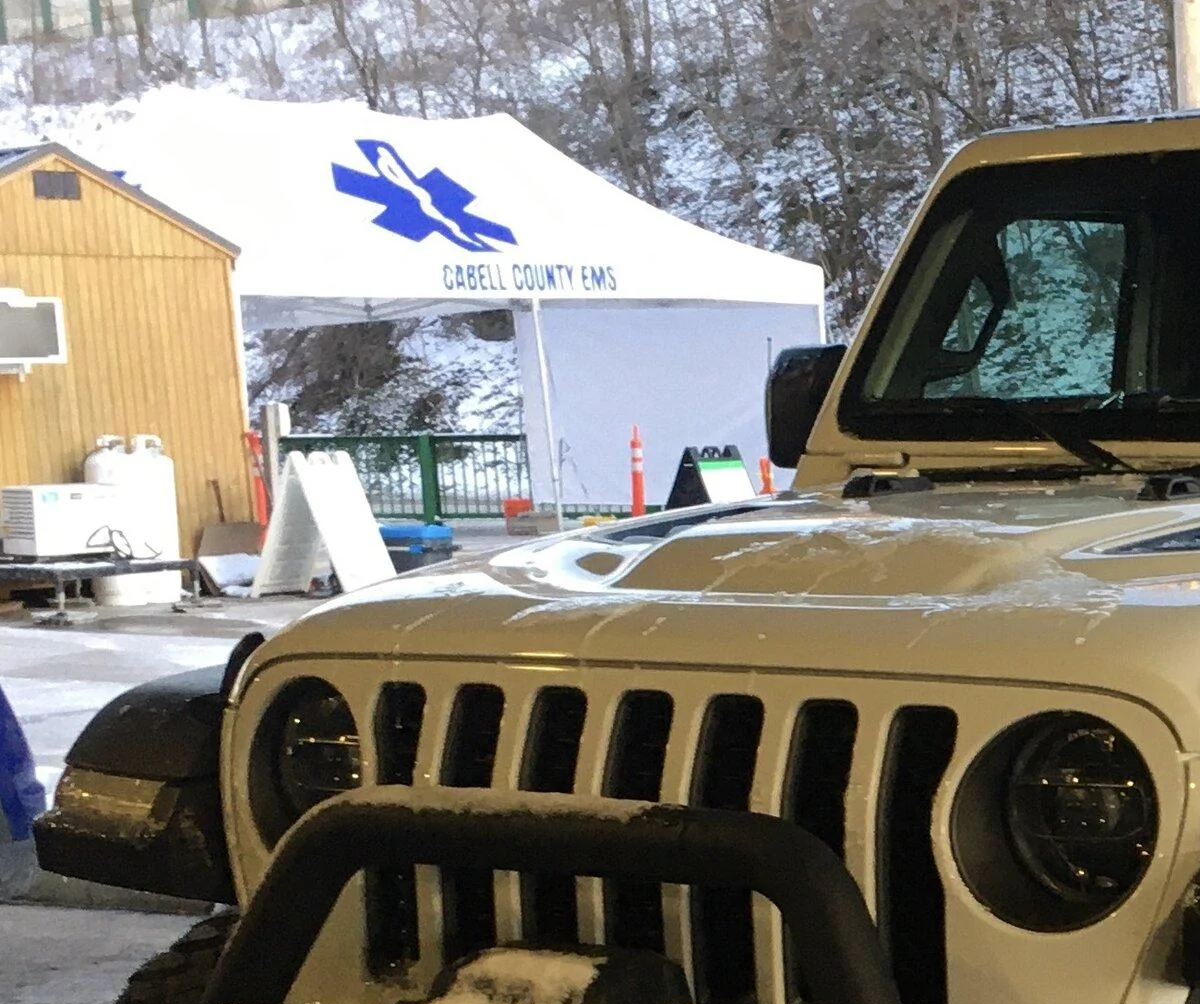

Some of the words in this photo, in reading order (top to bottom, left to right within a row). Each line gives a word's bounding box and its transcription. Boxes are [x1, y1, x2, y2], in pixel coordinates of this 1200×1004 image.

[442, 263, 506, 291] CABELL
[512, 264, 574, 291] COUNTY
[581, 265, 617, 291] EMS
